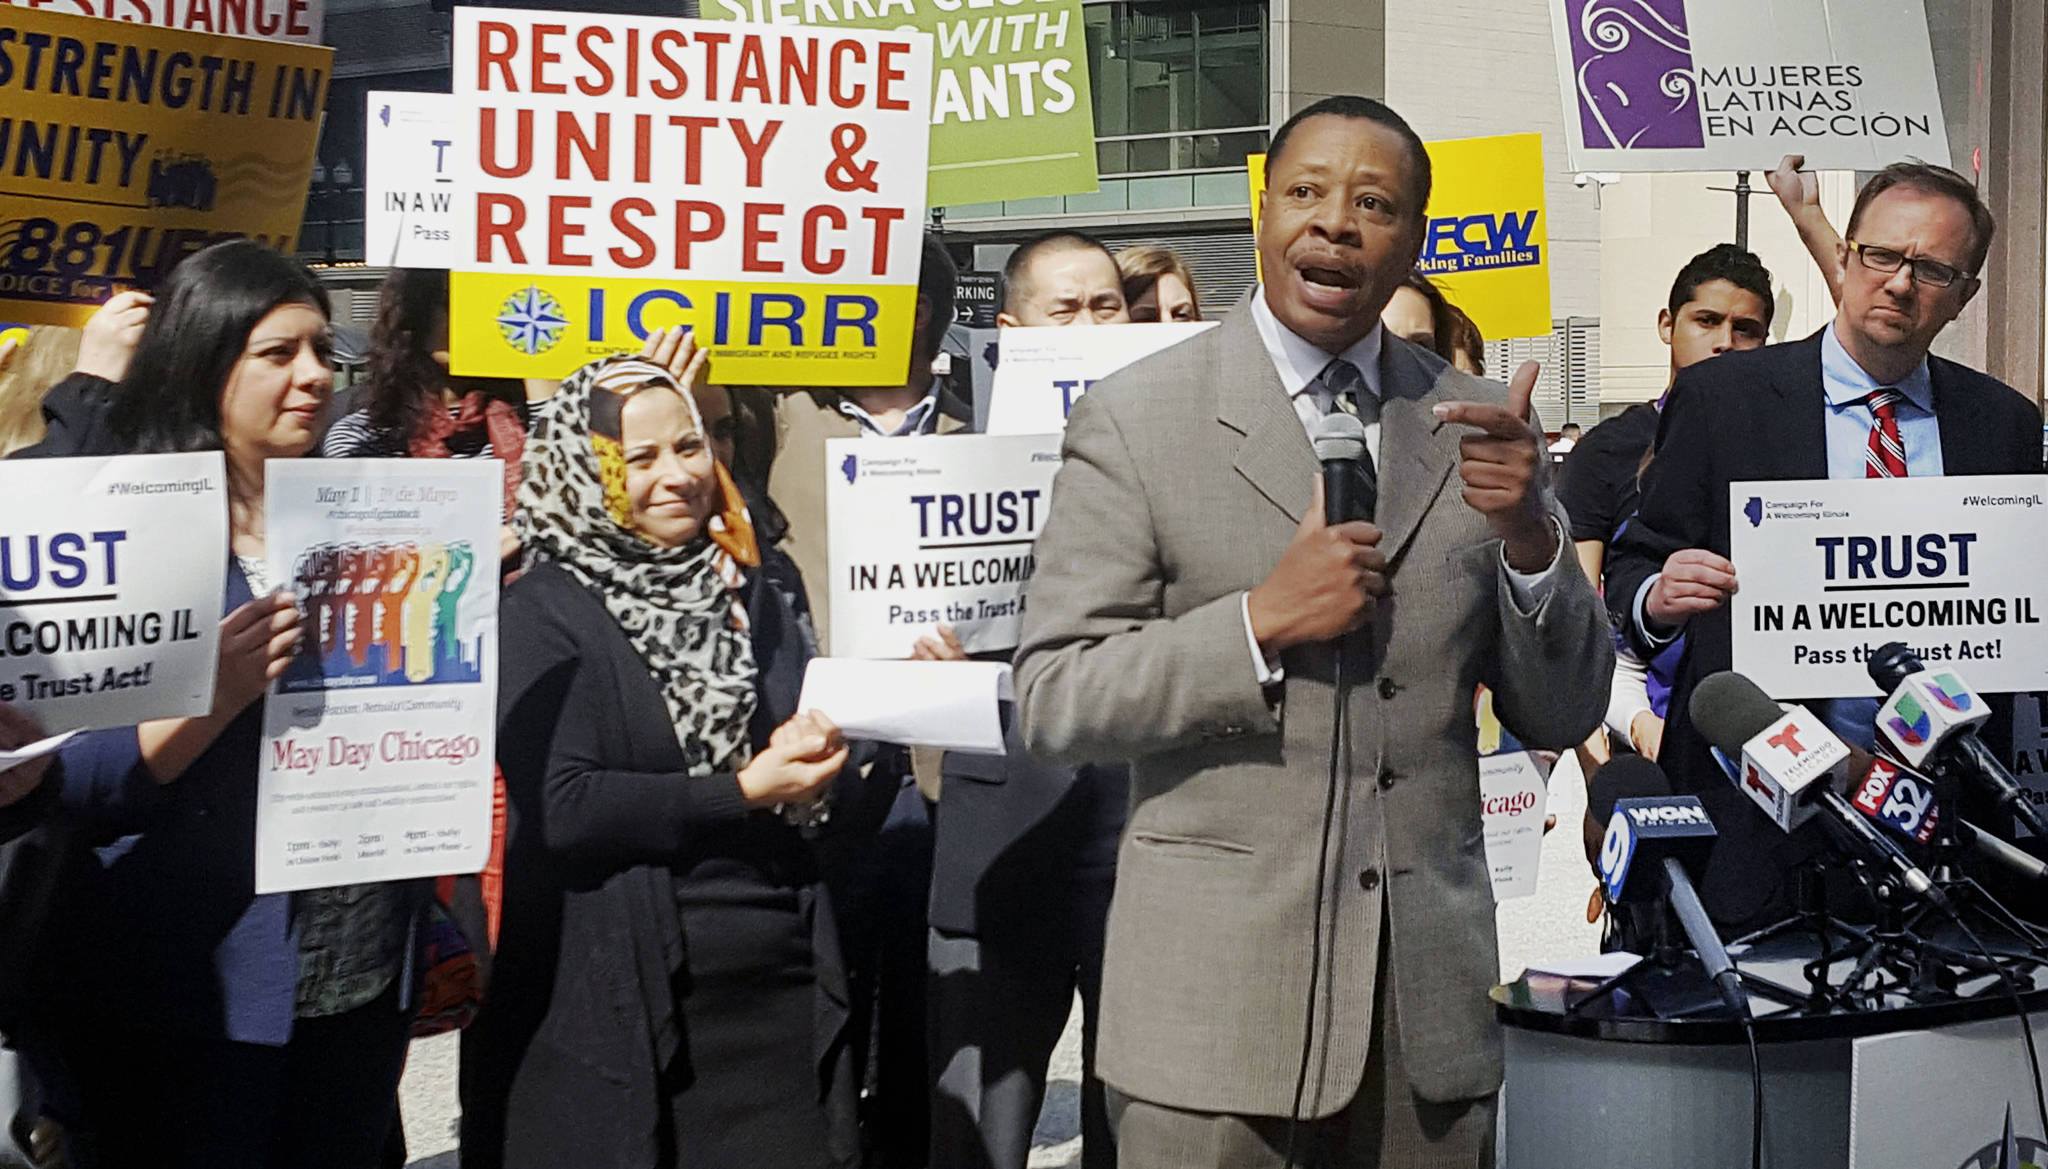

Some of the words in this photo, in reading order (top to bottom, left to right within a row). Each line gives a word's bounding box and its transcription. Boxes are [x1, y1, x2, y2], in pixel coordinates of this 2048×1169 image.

[936, 10, 1070, 59] WITH
[0, 27, 256, 115] STRENGTH
[268, 65, 323, 122] IN
[477, 20, 911, 112] RESISTANCE
[1701, 65, 1863, 88] MUJERES
[1703, 90, 1853, 112] LATINAS
[1707, 116, 1754, 137] EN
[1769, 111, 1931, 137] ACCIÓN
[0, 116, 149, 188] NITY
[479, 106, 783, 189] UNITY
[824, 122, 880, 194] &
[385, 191, 406, 214] IN
[412, 191, 425, 214] A
[475, 191, 905, 278] RESPECT
[1462, 249, 1534, 268] Families
[953, 286, 995, 300] RKING
[588, 287, 880, 348] ICIRR
[107, 478, 214, 496] #WelcomingIL
[1962, 494, 2044, 508] #WelcomingIL
[911, 489, 1041, 538] TRUST
[1815, 533, 1977, 580] TRUST
[850, 564, 878, 591] IN
[887, 563, 906, 590] A
[169, 608, 199, 642] IL
[888, 605, 940, 624] Pass
[946, 601, 974, 621] the
[977, 599, 1016, 619] Trust
[1753, 604, 1784, 631] IN
[1791, 604, 1812, 630] A
[1819, 597, 2007, 630] WELCOMING
[2014, 597, 2040, 624] IL
[1794, 644, 1847, 665] Pass
[1957, 638, 2002, 661] Act!
[20, 673, 94, 700] Trust
[100, 661, 155, 692] Act!
[270, 738, 321, 775] May
[326, 735, 375, 771] Day
[380, 729, 481, 766] Chicago
[1857, 763, 1896, 811] FOX
[1882, 777, 1934, 832] 32
[1628, 805, 1706, 821] WGN
[1601, 810, 1630, 887] 9
